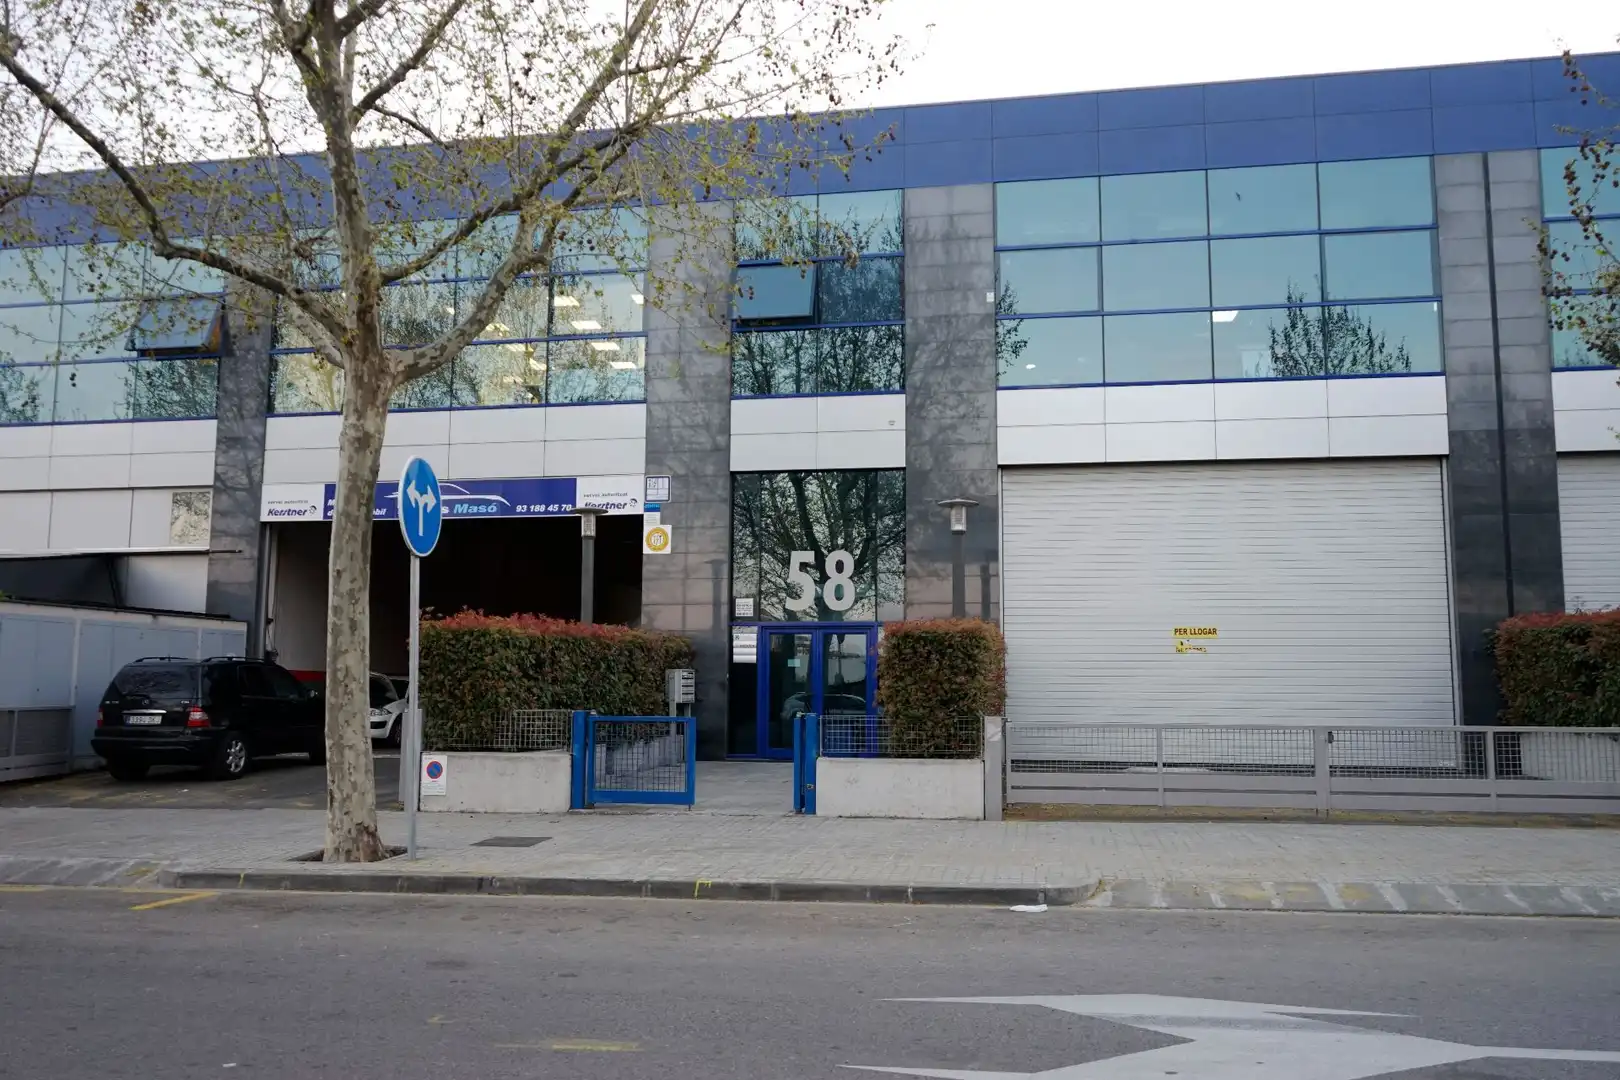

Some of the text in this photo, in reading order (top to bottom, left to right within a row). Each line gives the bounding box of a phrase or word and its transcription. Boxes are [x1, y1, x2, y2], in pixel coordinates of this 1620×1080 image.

[453, 503, 498, 514] Masó
[516, 504, 572, 513] 93 188 45 70
[785, 549, 856, 612] 58
[1174, 627, 1217, 636] PER LLOGAR
